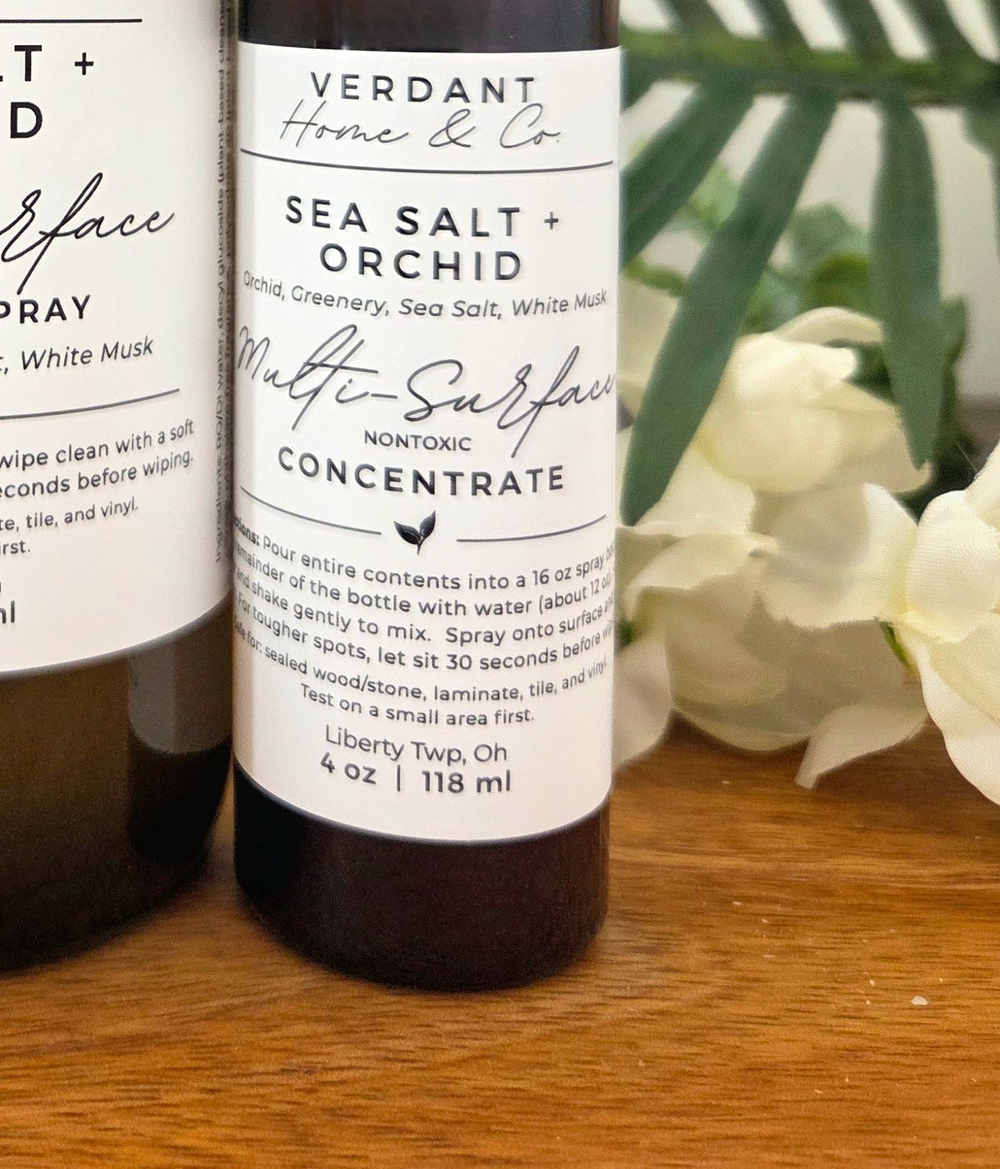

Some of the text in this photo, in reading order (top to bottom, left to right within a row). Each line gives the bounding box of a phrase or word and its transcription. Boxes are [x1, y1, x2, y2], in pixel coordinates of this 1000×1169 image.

[310, 72, 534, 103] VERDANT
[280, 98, 560, 149] Home & Co.
[286, 195, 367, 232] SEA
[395, 206, 520, 237] SALT
[320, 243, 521, 281] ORCHID
[244, 271, 606, 320] Orchid, Greenery, Sea Salt, White Musk
[22, 346, 92, 370] White
[101, 335, 153, 362] Musk
[56, 444, 108, 464] clean
[116, 431, 152, 454] with
[158, 431, 165, 444] a
[170, 419, 193, 441] soft
[365, 430, 471, 451] NONTOXIC
[78, 467, 137, 490] before
[143, 451, 193, 481] wiping.
[277, 445, 564, 496] CONCENTRATE
[26, 512, 58, 529] tile,
[64, 504, 95, 524] and
[101, 496, 138, 522] vinyl.
[263, 535, 297, 562] Pour
[301, 556, 356, 579] entire
[363, 567, 460, 590] contents
[468, 573, 509, 590] into
[515, 576, 526, 589] a
[532, 569, 549, 586] 16
[554, 566, 572, 581] oz
[574, 555, 604, 583] spray
[251, 581, 288, 611] shake
[293, 603, 351, 636] gently
[358, 618, 379, 636] to
[387, 624, 431, 641] mix.
[446, 627, 505, 648] Spray
[512, 624, 554, 642] onto
[559, 604, 603, 633] surface
[289, 574, 306, 591] of
[309, 580, 341, 601] the
[347, 588, 411, 612] bottle
[418, 599, 467, 616] with
[475, 598, 531, 616] water
[539, 587, 587, 615] (about
[590, 579, 600, 597] 12
[252, 605, 308, 644] tougher
[313, 638, 371, 662] spots,
[378, 646, 406, 668] let
[413, 652, 439, 669] sit
[446, 653, 472, 671] 30
[480, 648, 557, 670] seconds
[562, 631, 601, 659] before
[247, 635, 263, 655] for:
[265, 648, 308, 675] sealed
[313, 667, 428, 701] wood/stone,
[434, 685, 524, 702] laminate,
[529, 678, 558, 698] tile,
[561, 667, 585, 691] and
[301, 683, 534, 726] Test on a small area first.
[324, 724, 507, 766] Liberty Twp, Oh
[321, 752, 335, 774] 4
[344, 763, 376, 785] oz
[422, 771, 464, 794] 118
[477, 770, 510, 793] ml
